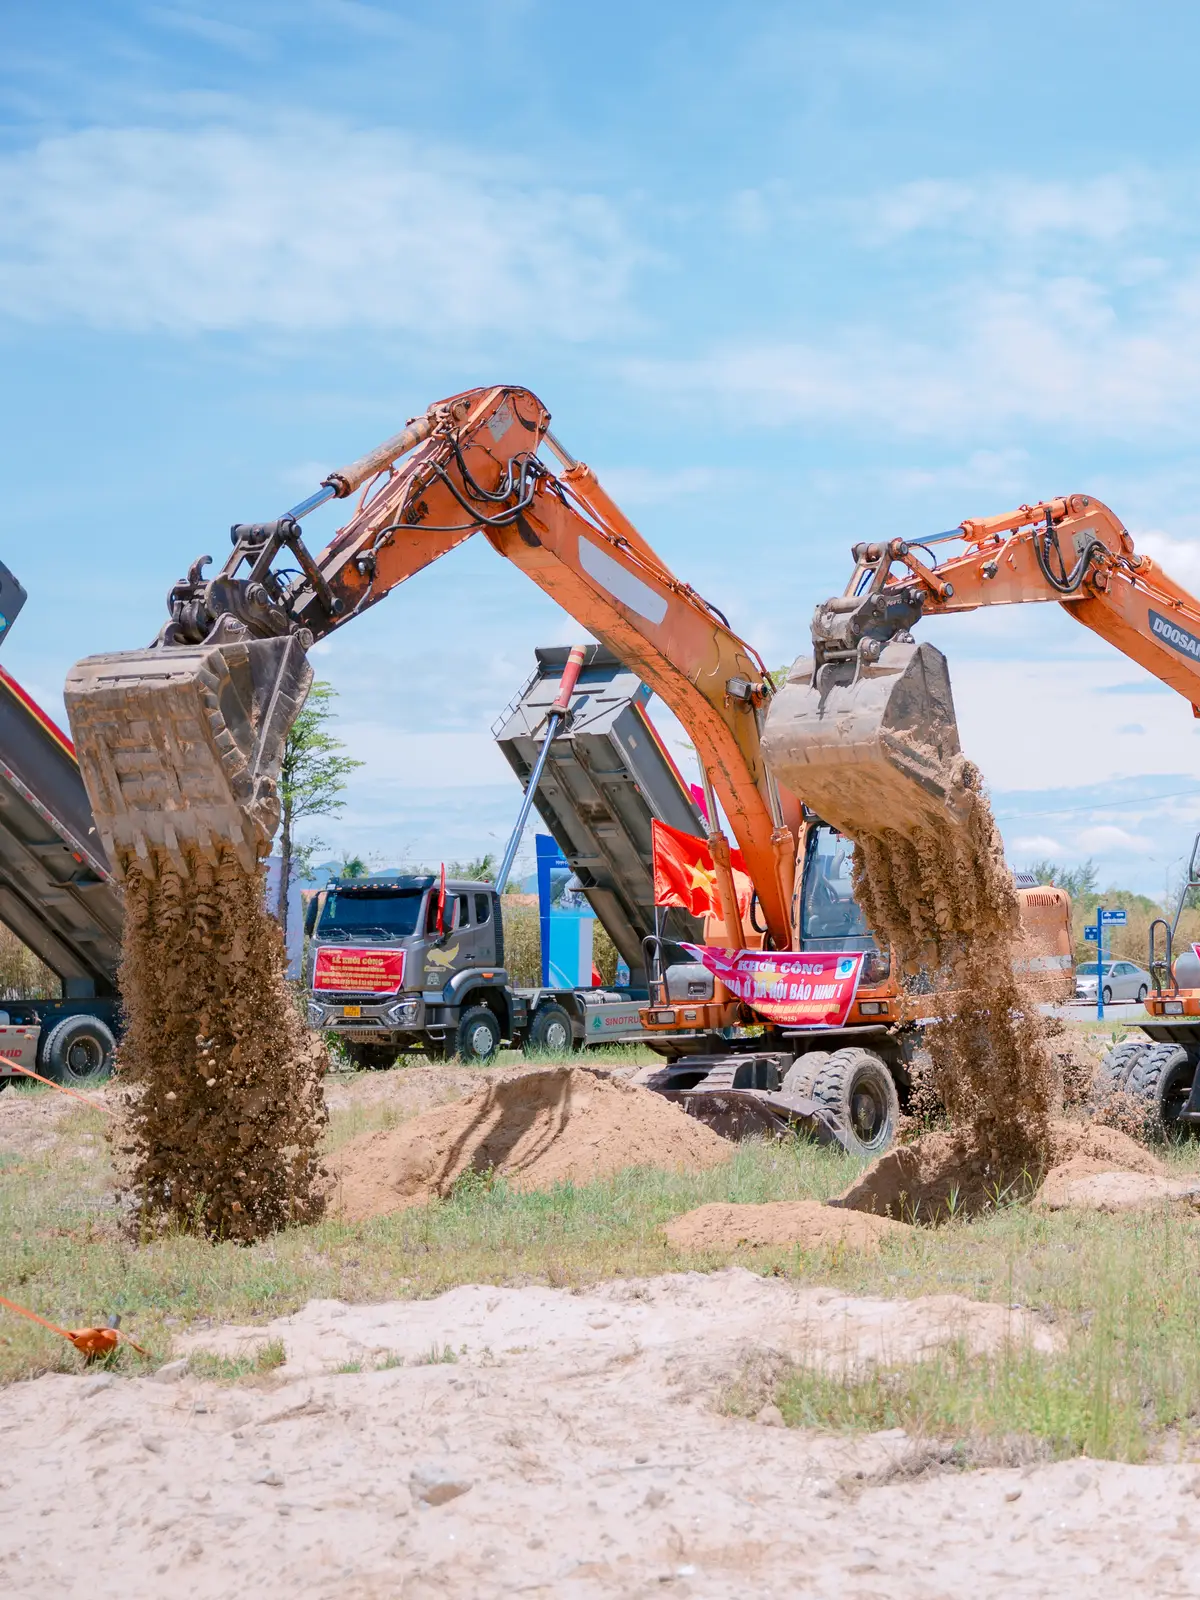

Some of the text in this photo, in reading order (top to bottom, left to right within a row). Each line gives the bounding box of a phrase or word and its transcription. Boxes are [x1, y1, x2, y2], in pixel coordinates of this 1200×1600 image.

[780, 960, 824, 976] CÔNG
[743, 975, 752, 998] Ở
[789, 978, 811, 1001] BẢO
[811, 983, 838, 1001] NINH
[836, 983, 844, 998] 1
